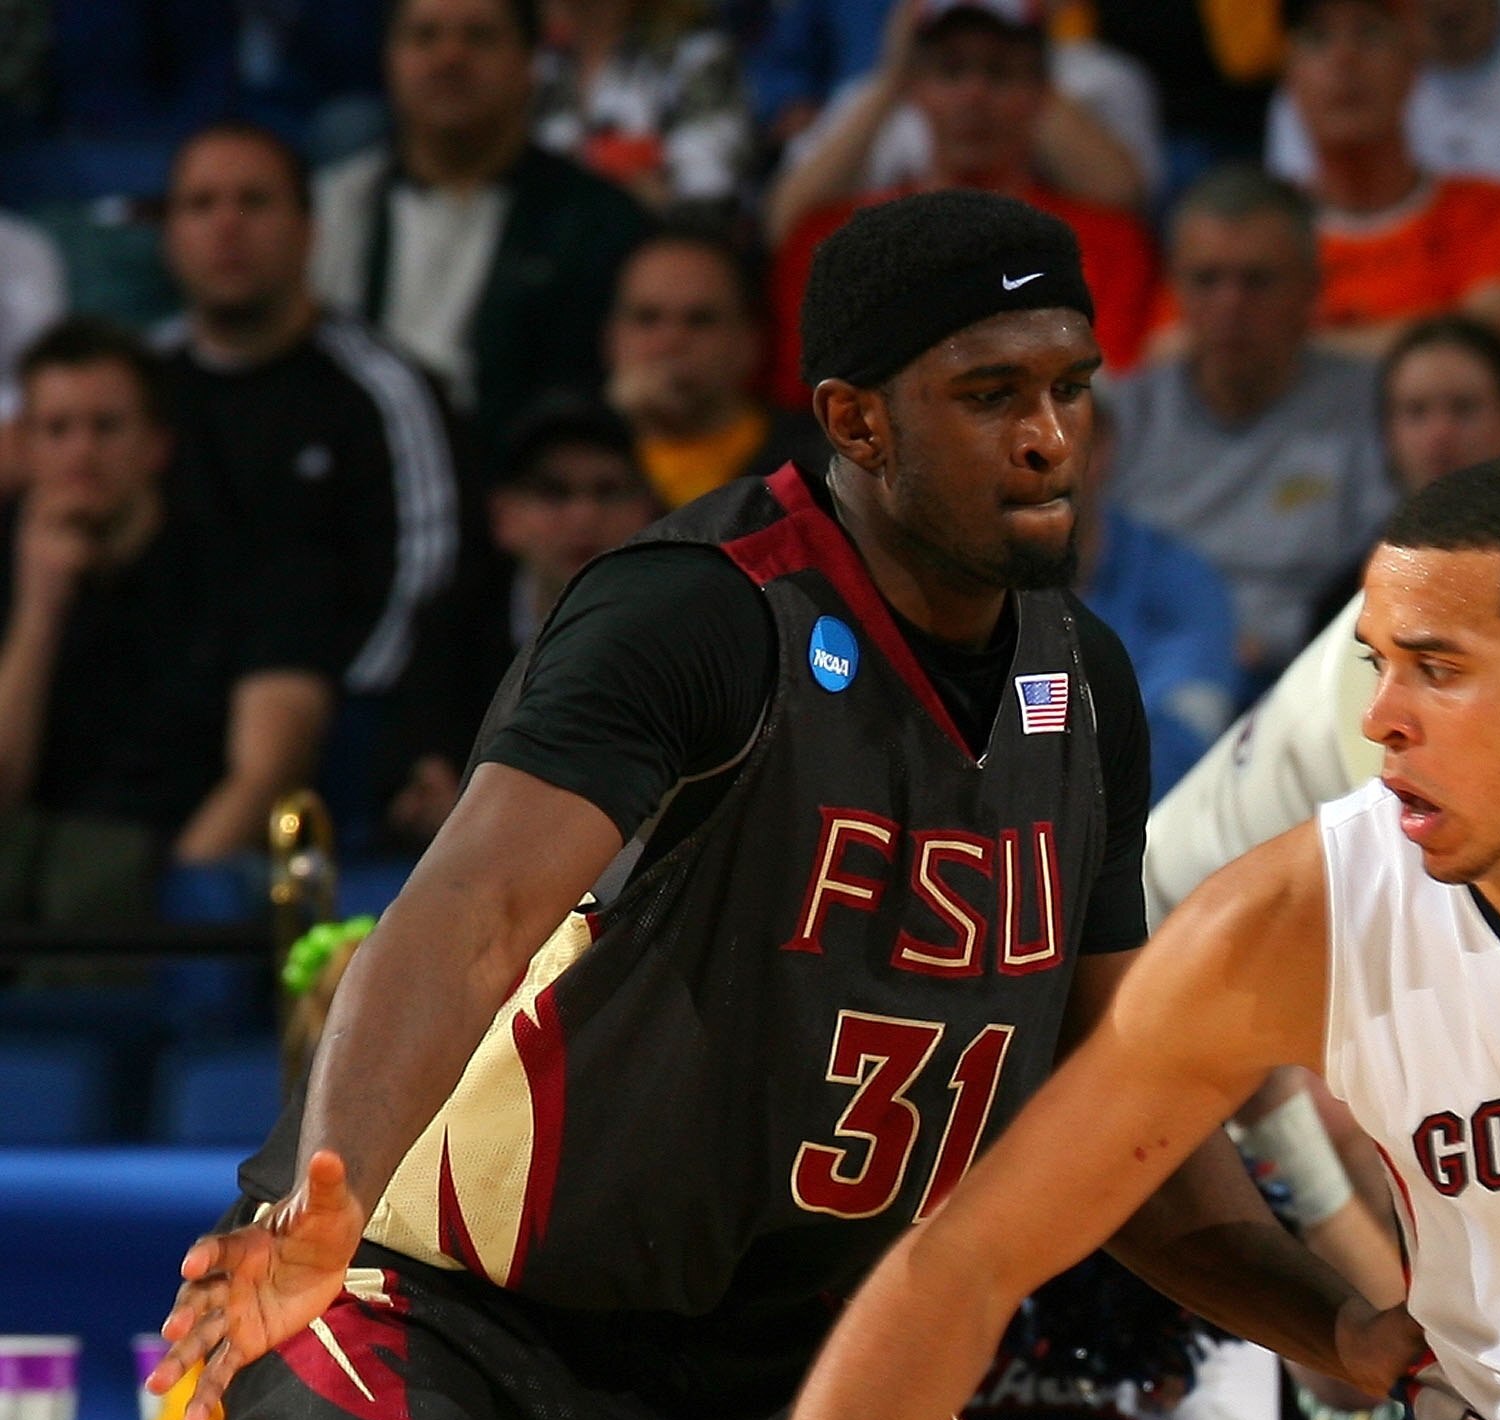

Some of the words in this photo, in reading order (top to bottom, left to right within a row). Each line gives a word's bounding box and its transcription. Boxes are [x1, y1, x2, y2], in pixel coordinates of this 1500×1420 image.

[813, 648, 849, 677] NCAA
[779, 805, 1065, 977] FSU
[791, 1009, 1015, 1224] 31
